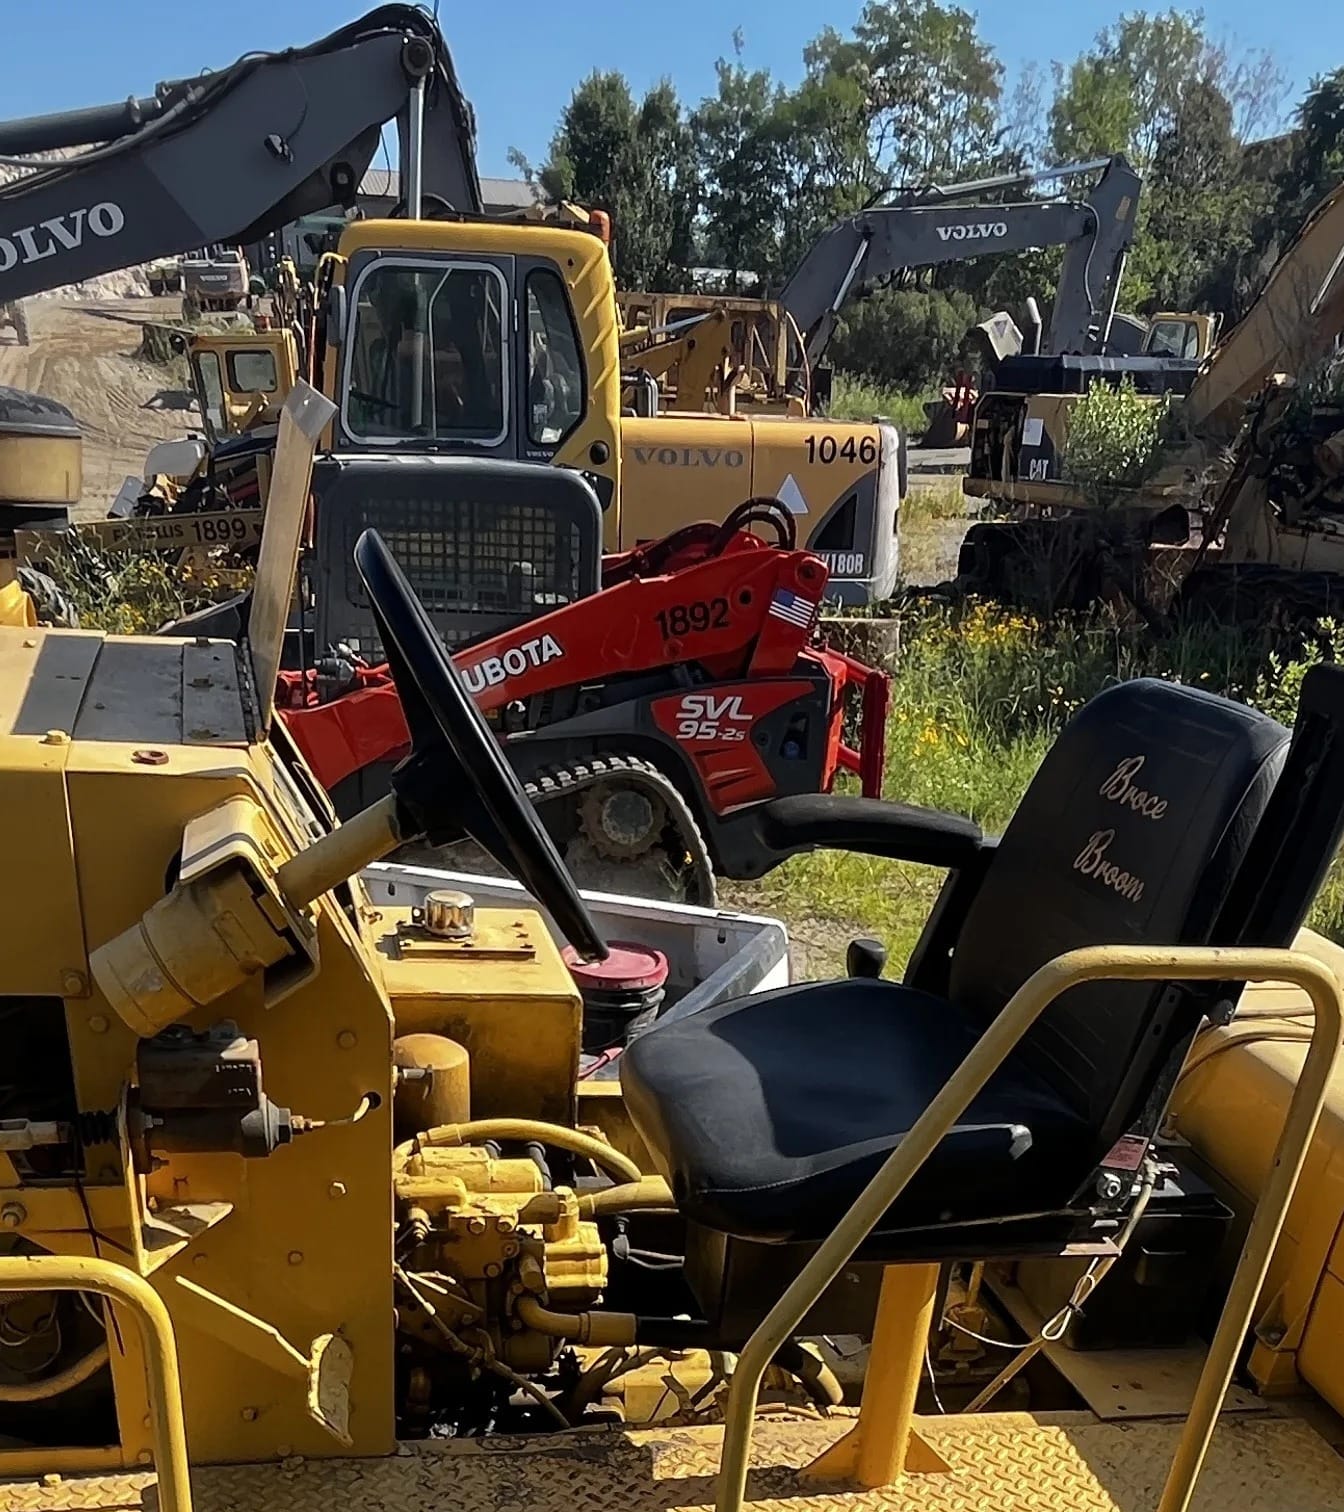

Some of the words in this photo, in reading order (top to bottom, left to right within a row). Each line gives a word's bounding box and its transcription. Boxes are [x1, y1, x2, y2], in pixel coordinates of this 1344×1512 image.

[936, 222, 1008, 241] VOLVO
[631, 446, 744, 468] VOLVO
[804, 435, 876, 464] 1046
[1029, 458, 1049, 481] CAT
[191, 518, 247, 542] 1899
[655, 597, 730, 641] 1892
[460, 634, 563, 694] UBOTA
[675, 695, 754, 721] SVL
[1072, 828, 1147, 904] Broom
